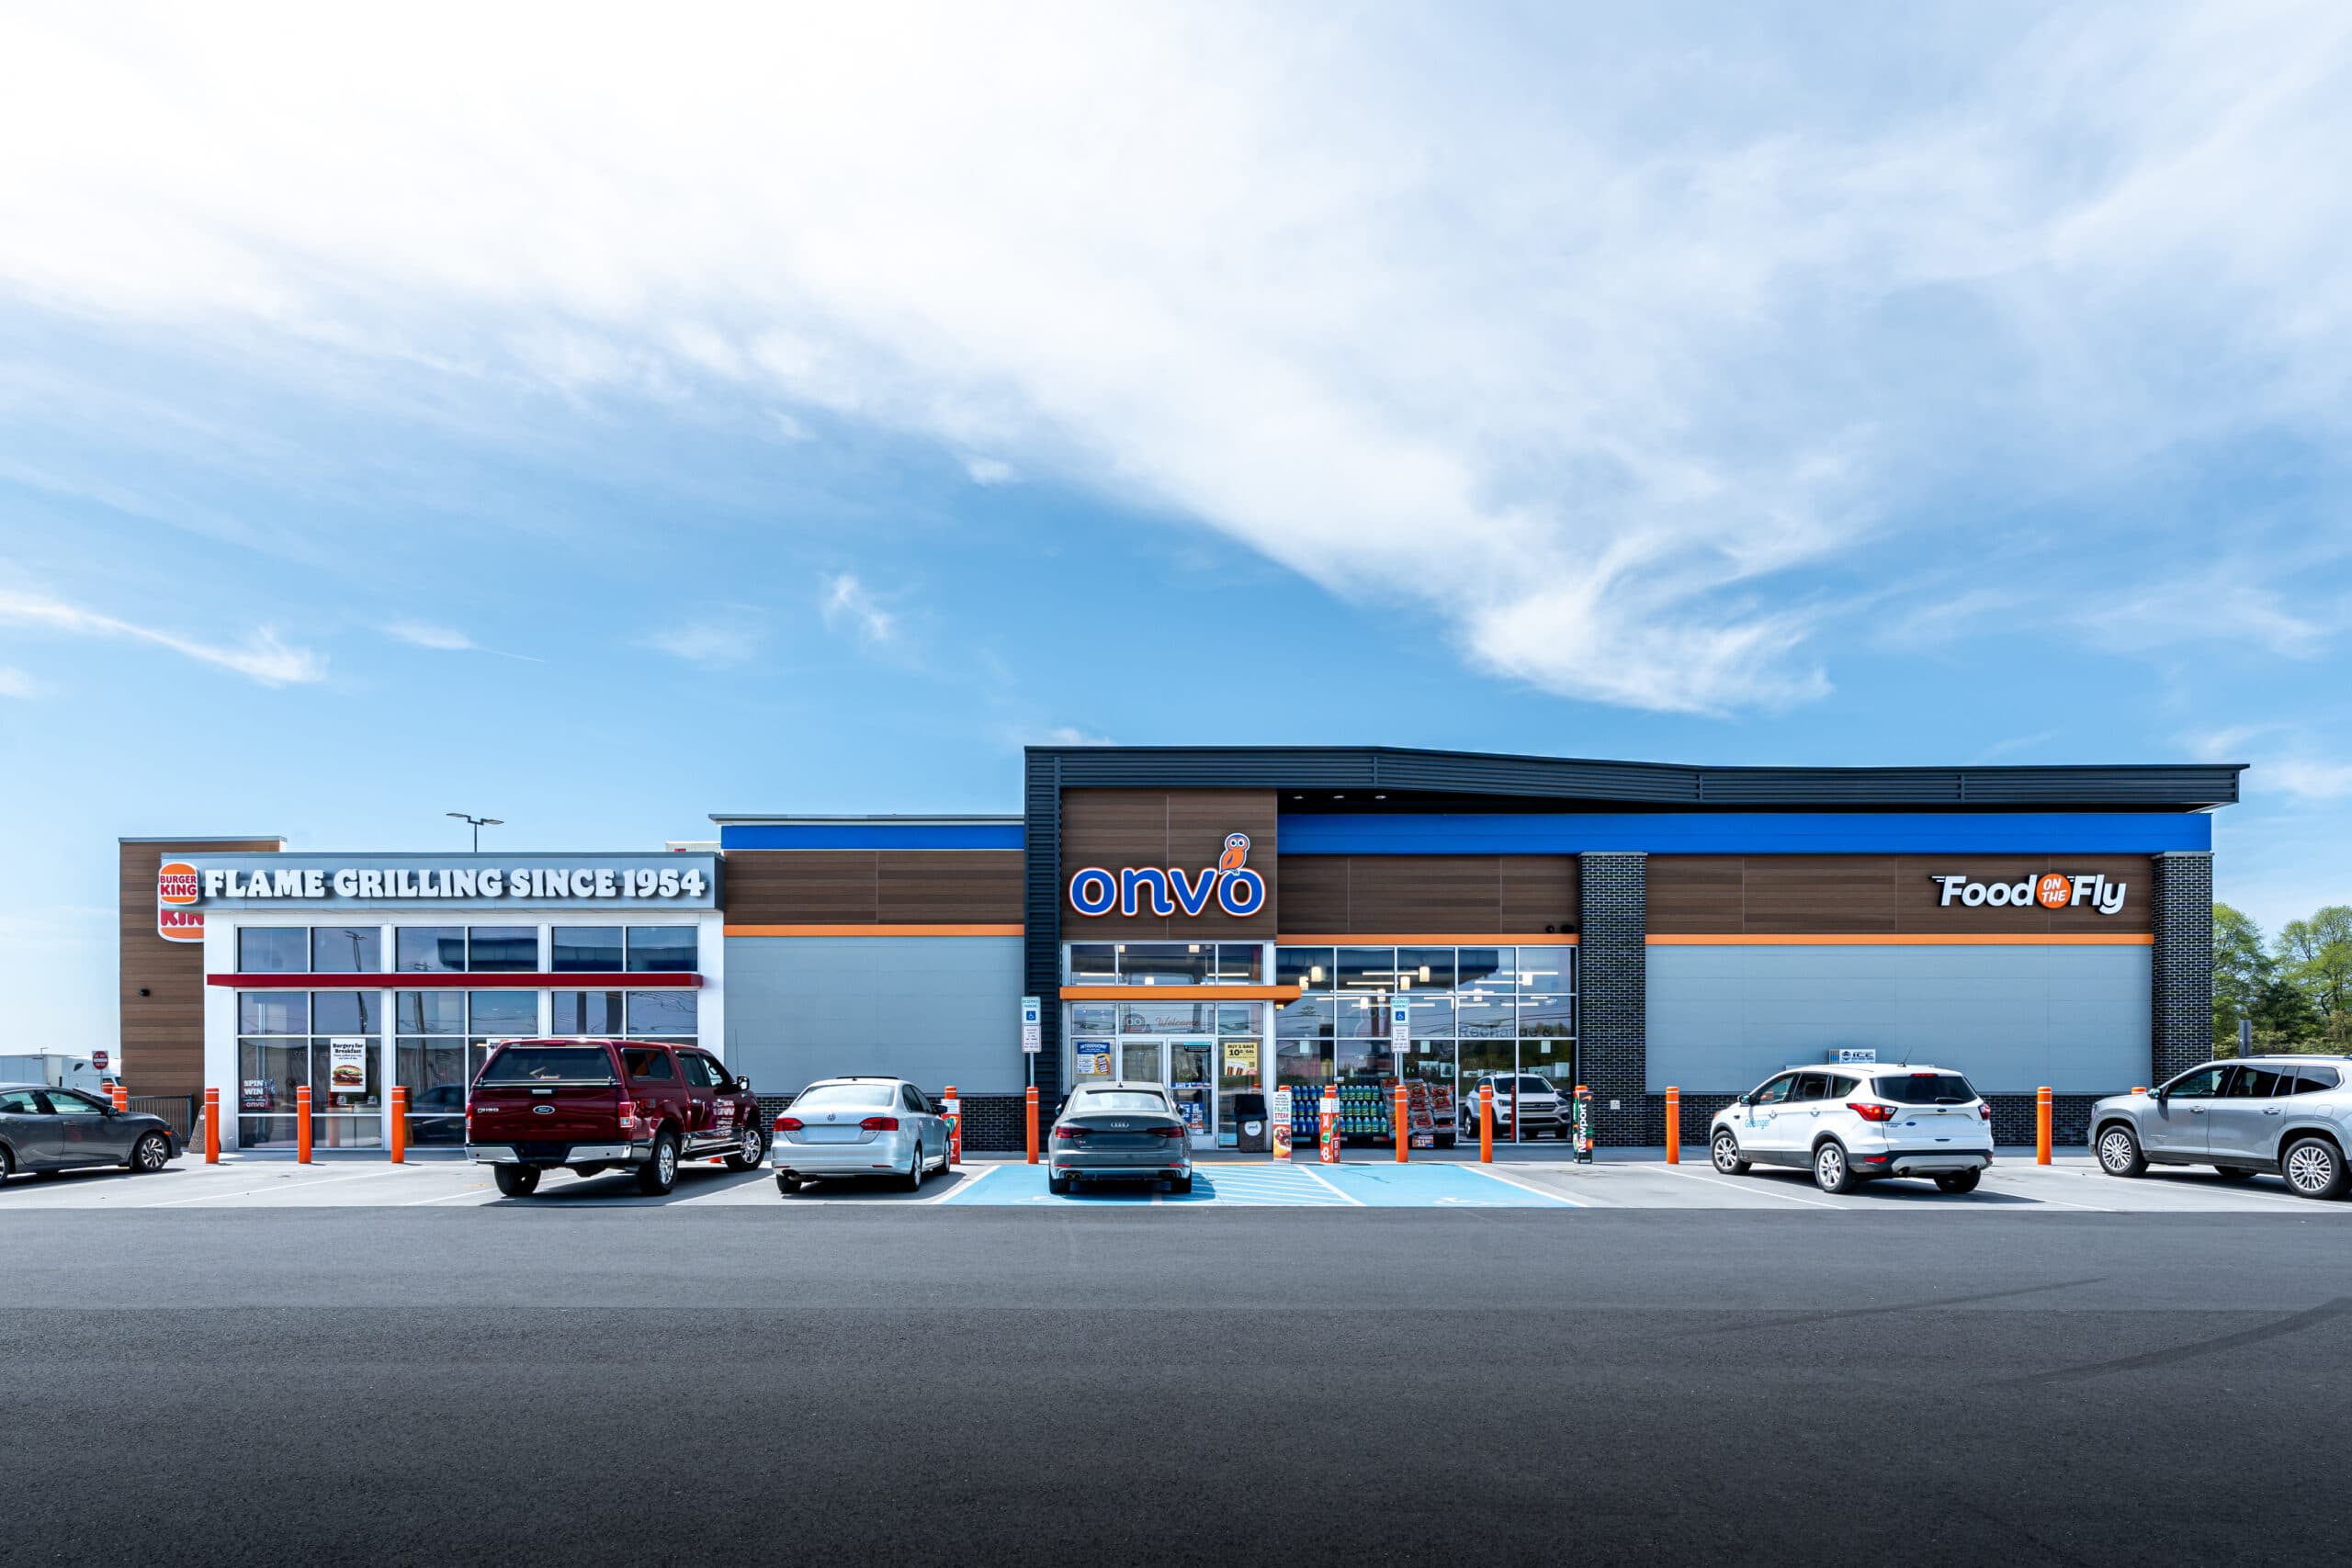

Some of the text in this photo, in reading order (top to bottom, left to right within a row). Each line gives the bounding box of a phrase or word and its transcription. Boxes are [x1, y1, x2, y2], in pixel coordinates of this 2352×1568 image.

[160, 875, 197, 884] BURGER
[205, 868, 706, 897] FLAME GRILLING SINCE 1954
[2042, 878, 2062, 891] ON
[160, 885, 198, 896] KING
[1069, 867, 1267, 917] onvo
[1933, 874, 2038, 907] Food
[2041, 889, 2067, 904] THE
[2068, 874, 2127, 915] Fly
[161, 908, 205, 927] KIN
[1155, 1016, 1201, 1027] Welcome
[1578, 1103, 1588, 1153] Newport
